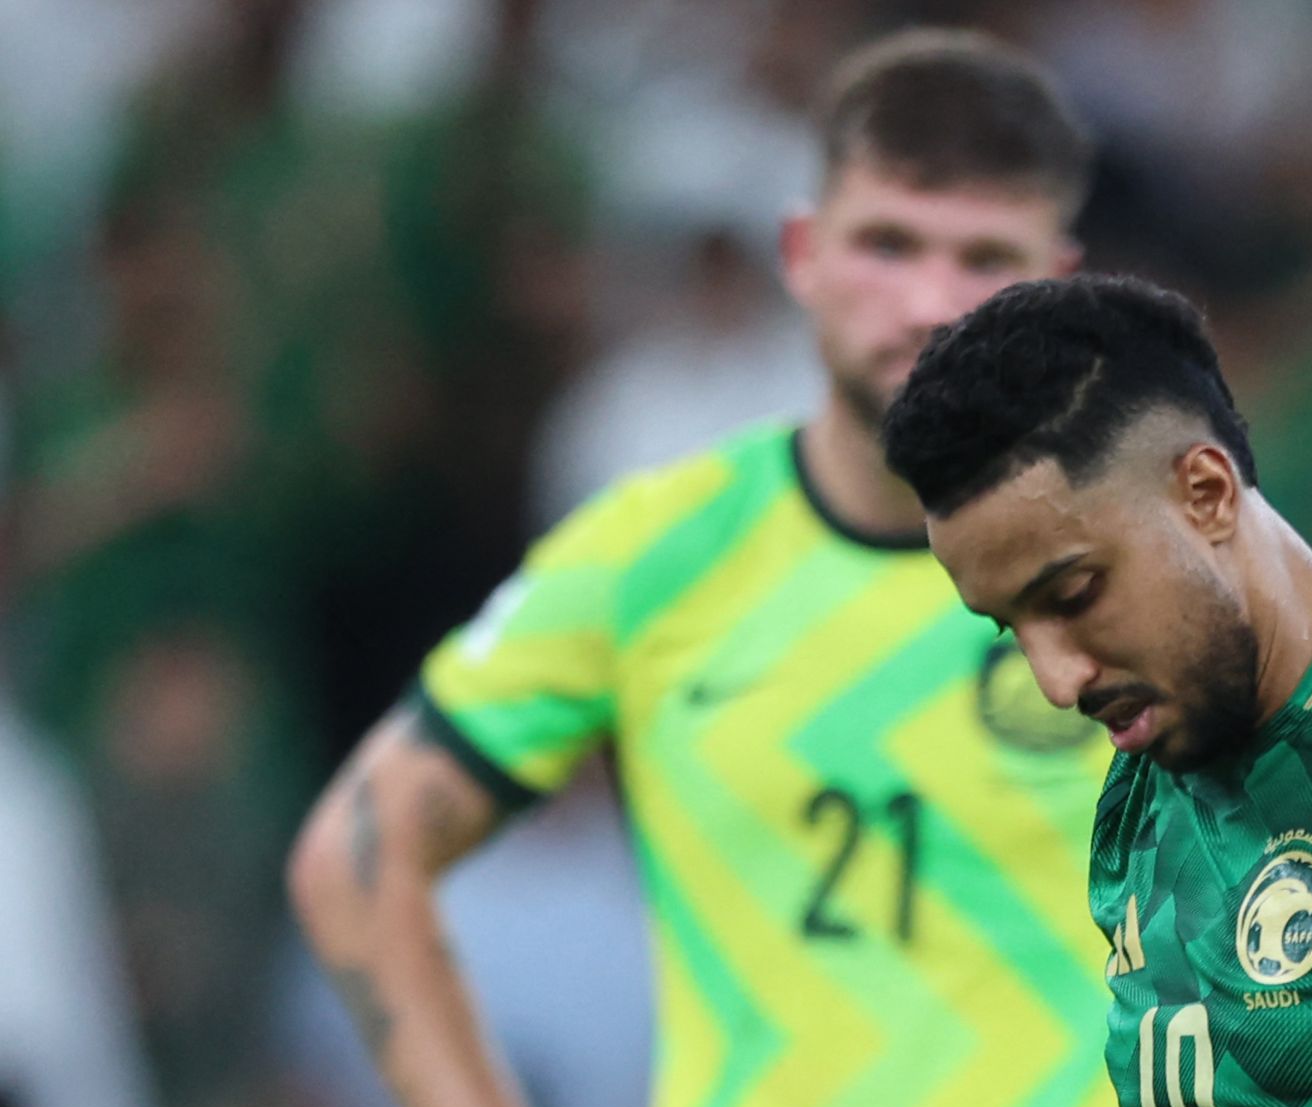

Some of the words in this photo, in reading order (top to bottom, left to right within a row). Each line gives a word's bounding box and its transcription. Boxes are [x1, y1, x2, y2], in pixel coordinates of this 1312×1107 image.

[799, 789, 923, 942] 21
[1284, 931, 1312, 945] SAFF
[1243, 989, 1301, 1011] SAUDI
